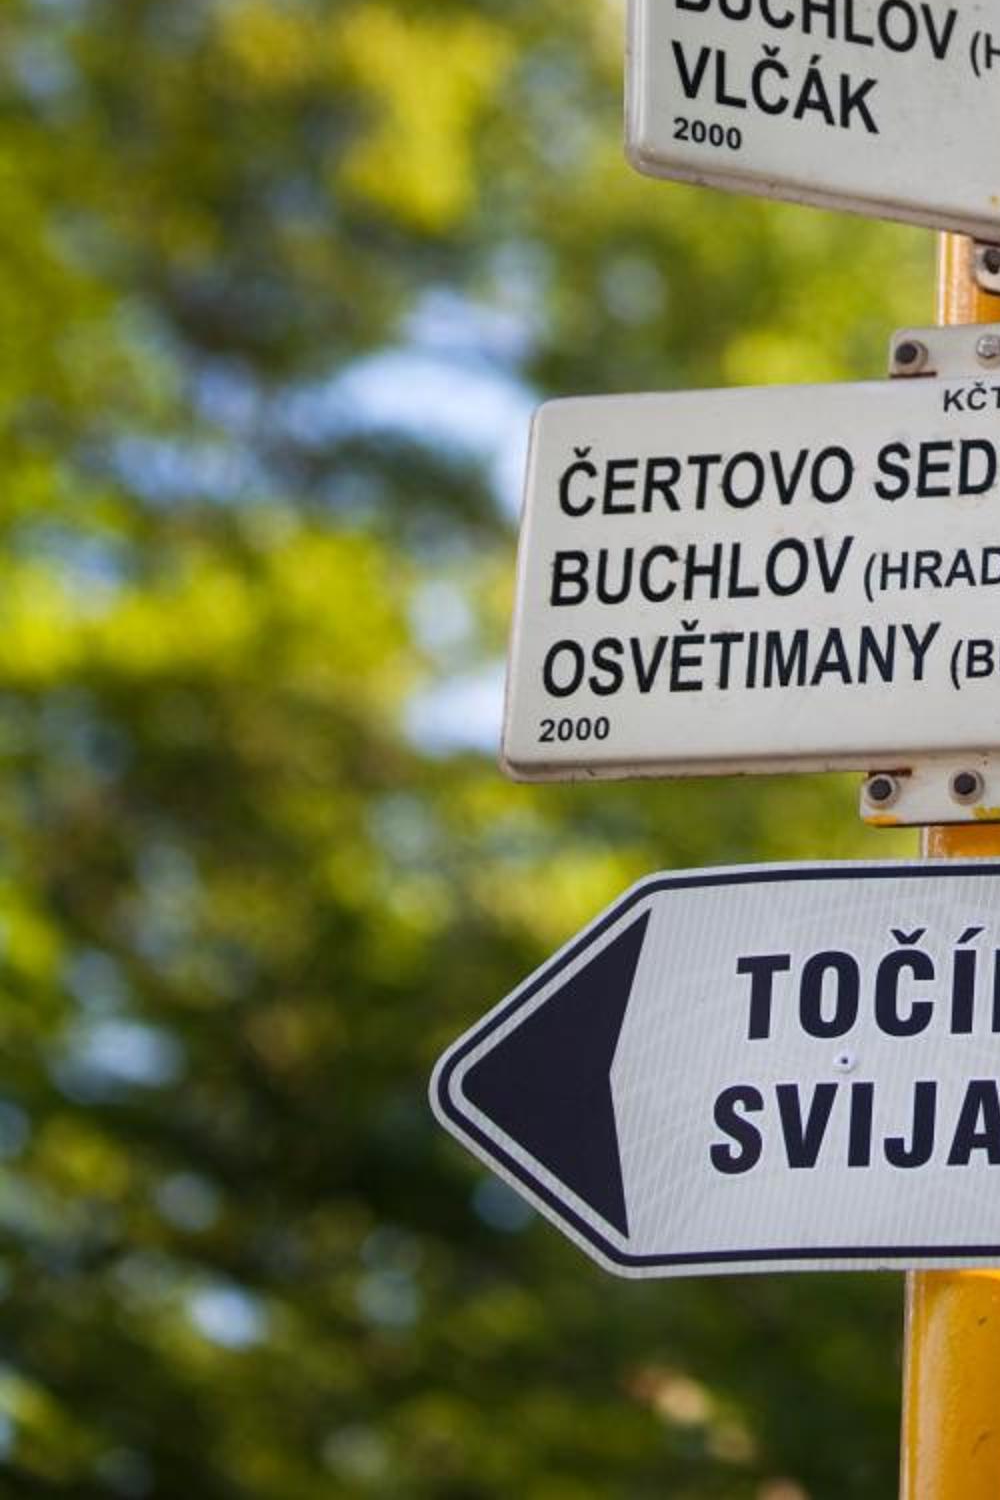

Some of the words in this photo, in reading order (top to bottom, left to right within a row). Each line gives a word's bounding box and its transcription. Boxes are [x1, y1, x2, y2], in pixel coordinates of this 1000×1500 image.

[671, 39, 880, 135] VLČÁK
[672, 117, 742, 150] 2000
[557, 446, 855, 517] ČERTOVO
[549, 536, 855, 607] BUCHLOV
[542, 619, 941, 697] OSVĚTIMANY
[538, 717, 611, 743] 2000
